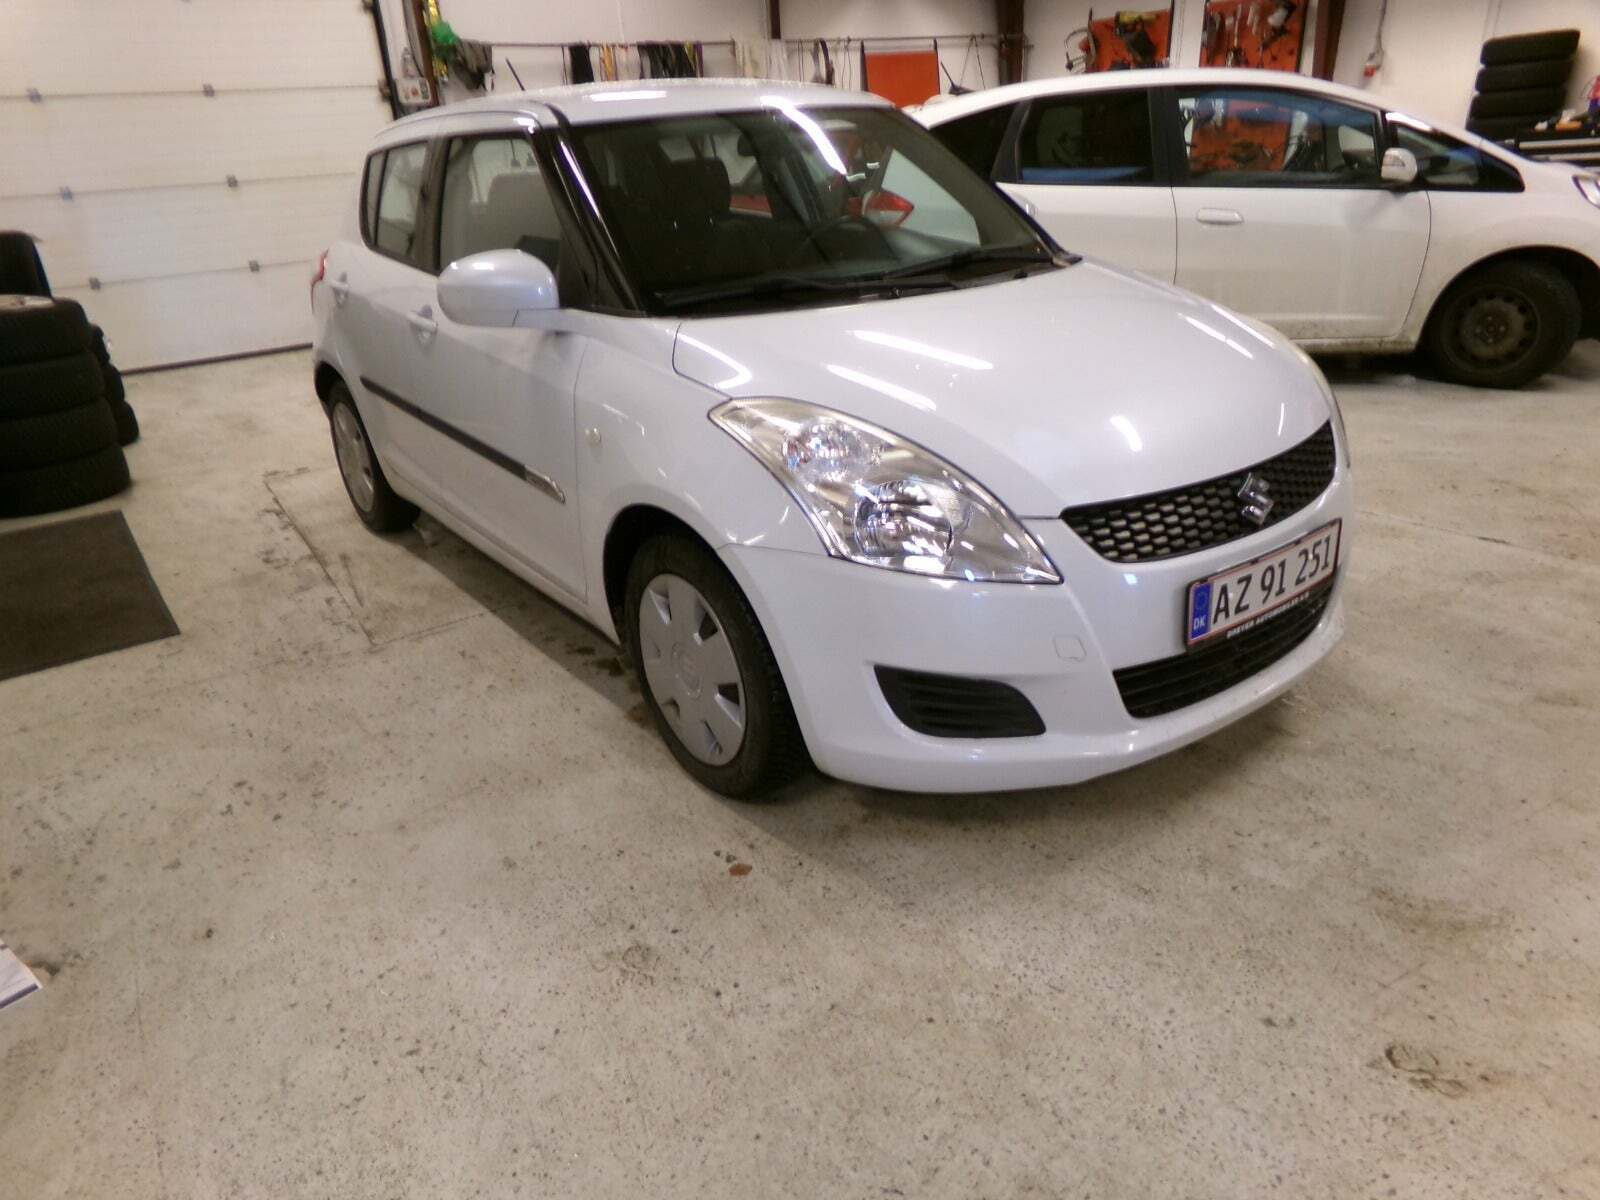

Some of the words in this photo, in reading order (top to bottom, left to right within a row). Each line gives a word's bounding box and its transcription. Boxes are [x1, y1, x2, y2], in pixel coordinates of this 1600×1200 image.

[1212, 573, 1253, 625] AZ
[1260, 559, 1287, 605] 91
[1295, 535, 1332, 586] 251
[1193, 615, 1207, 630] DK
